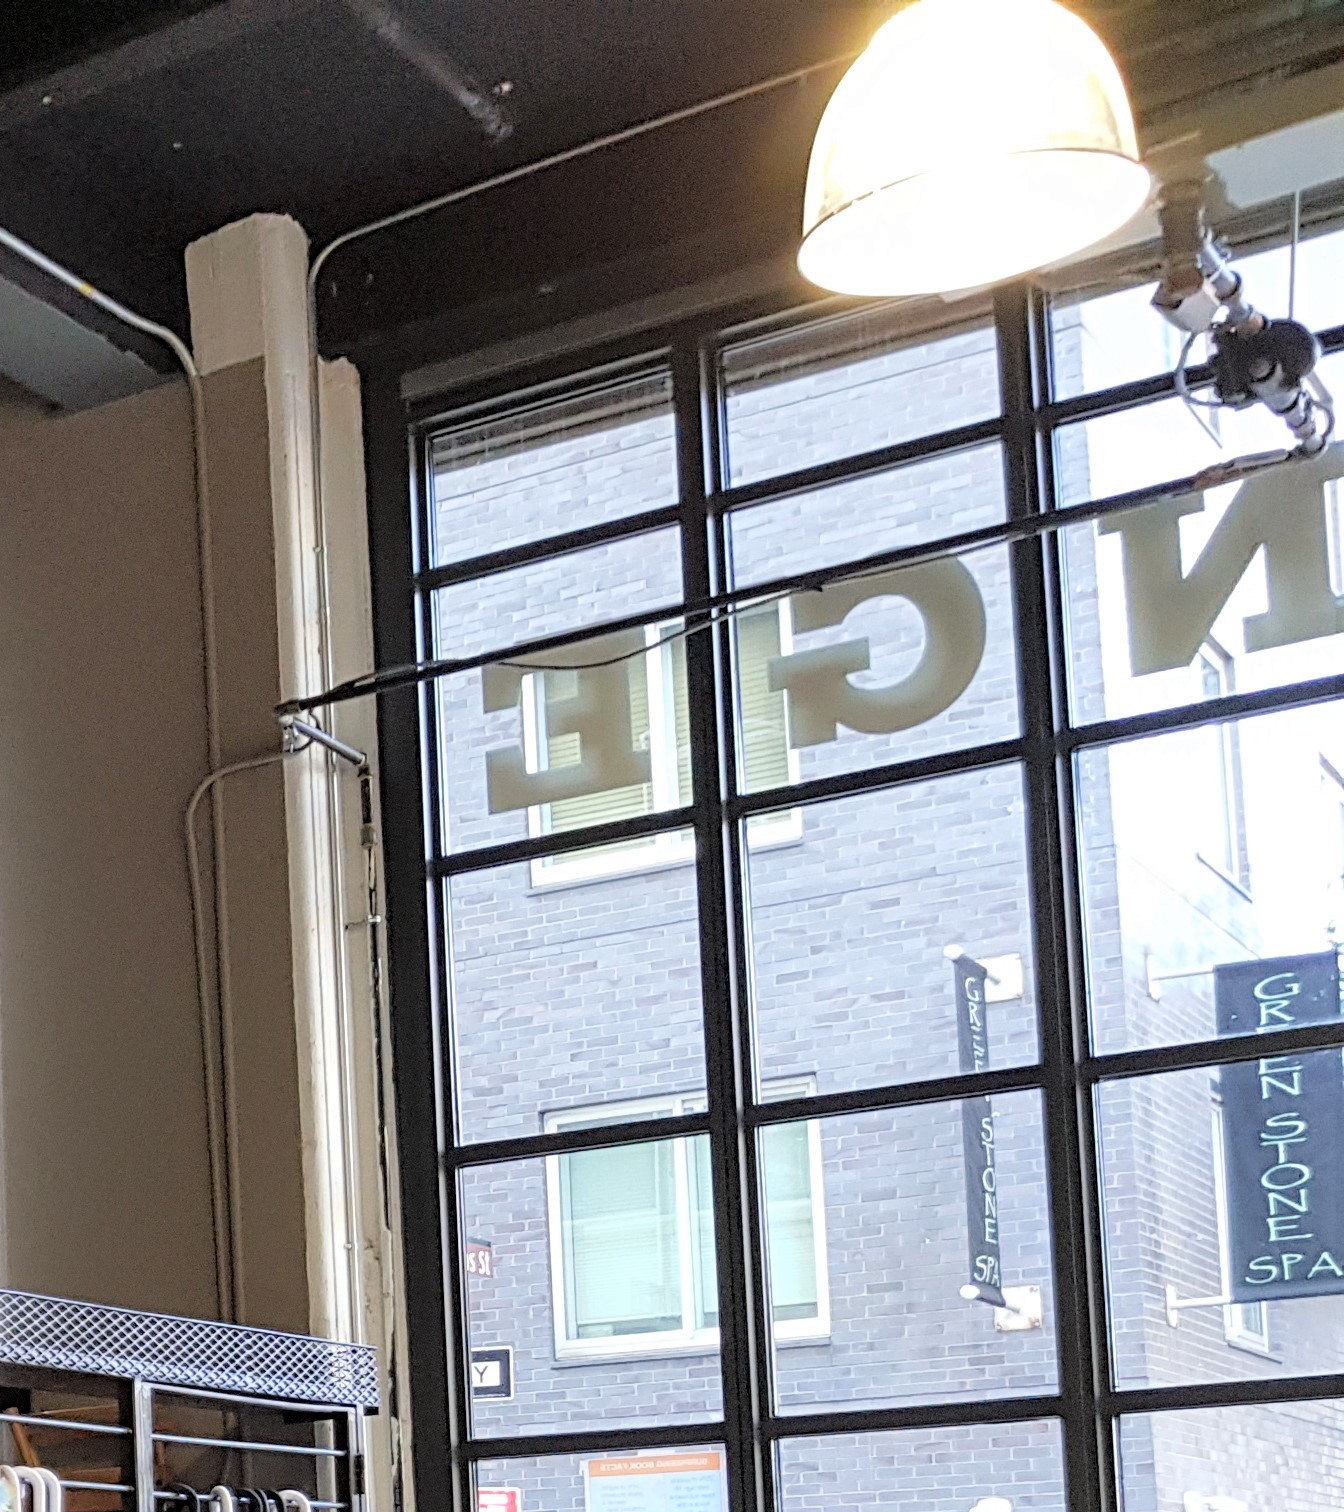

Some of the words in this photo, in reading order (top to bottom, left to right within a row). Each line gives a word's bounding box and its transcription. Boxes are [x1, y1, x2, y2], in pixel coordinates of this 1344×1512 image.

[980, 1111, 1001, 1246] STONE
[1259, 1112, 1312, 1243] STONE
[973, 1254, 1002, 1288] SPA
[1245, 1251, 1344, 1284] SPA
